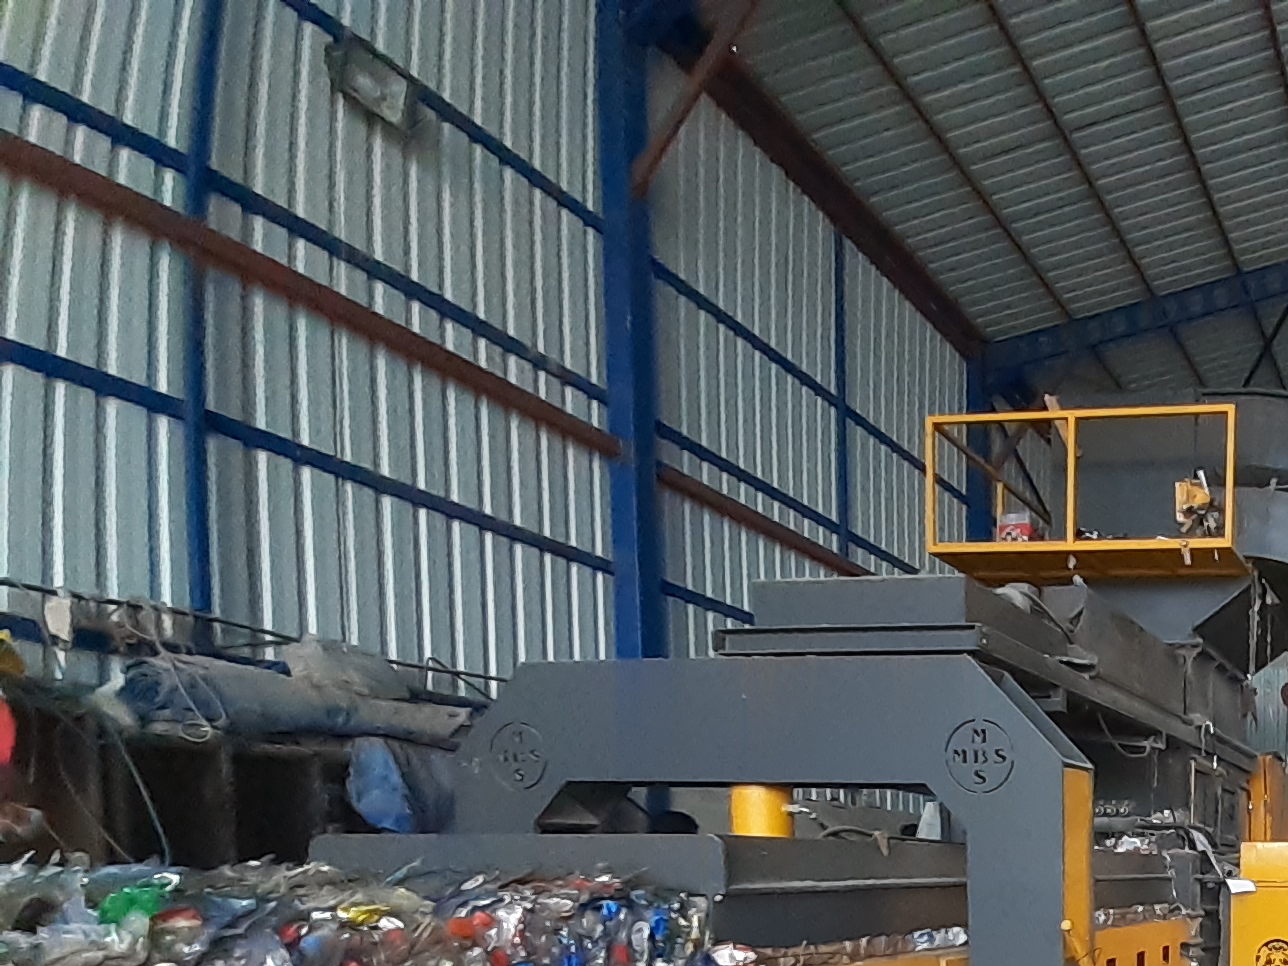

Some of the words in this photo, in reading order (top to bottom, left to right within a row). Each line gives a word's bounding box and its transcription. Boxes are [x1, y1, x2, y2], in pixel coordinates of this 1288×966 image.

[972, 728, 987, 744] M
[953, 748, 1007, 765] MBS
[973, 769, 987, 785] S
